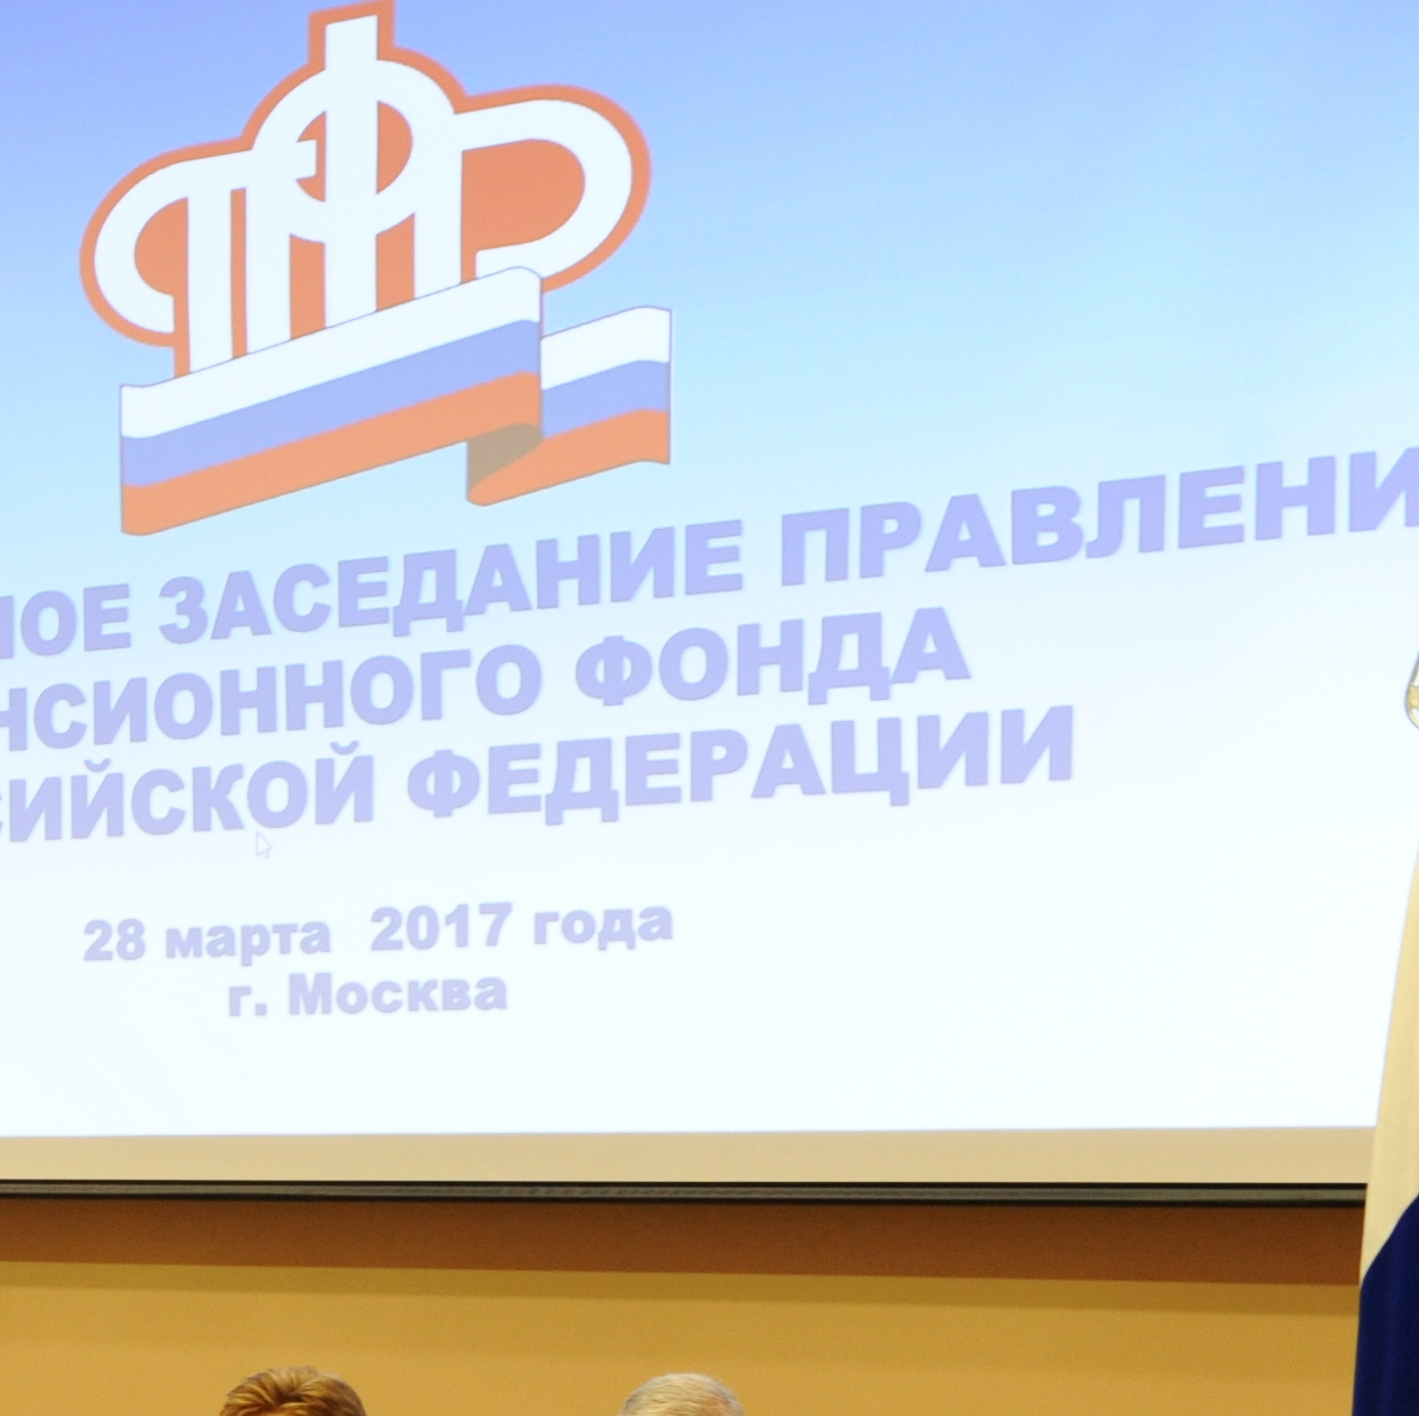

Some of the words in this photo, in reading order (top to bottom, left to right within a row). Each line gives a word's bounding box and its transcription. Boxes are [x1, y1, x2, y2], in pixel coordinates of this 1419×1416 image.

[159, 519, 743, 644] ЗАСЕДАНИЕ
[575, 607, 971, 706] ФОНДА
[408, 705, 1073, 826] ФЕДЕРАЦИИ
[84, 919, 145, 961] 28
[166, 922, 331, 967] марта
[371, 902, 512, 951] 2017
[535, 907, 672, 951] года
[229, 986, 267, 1017] г.
[289, 973, 507, 1015] Москва
